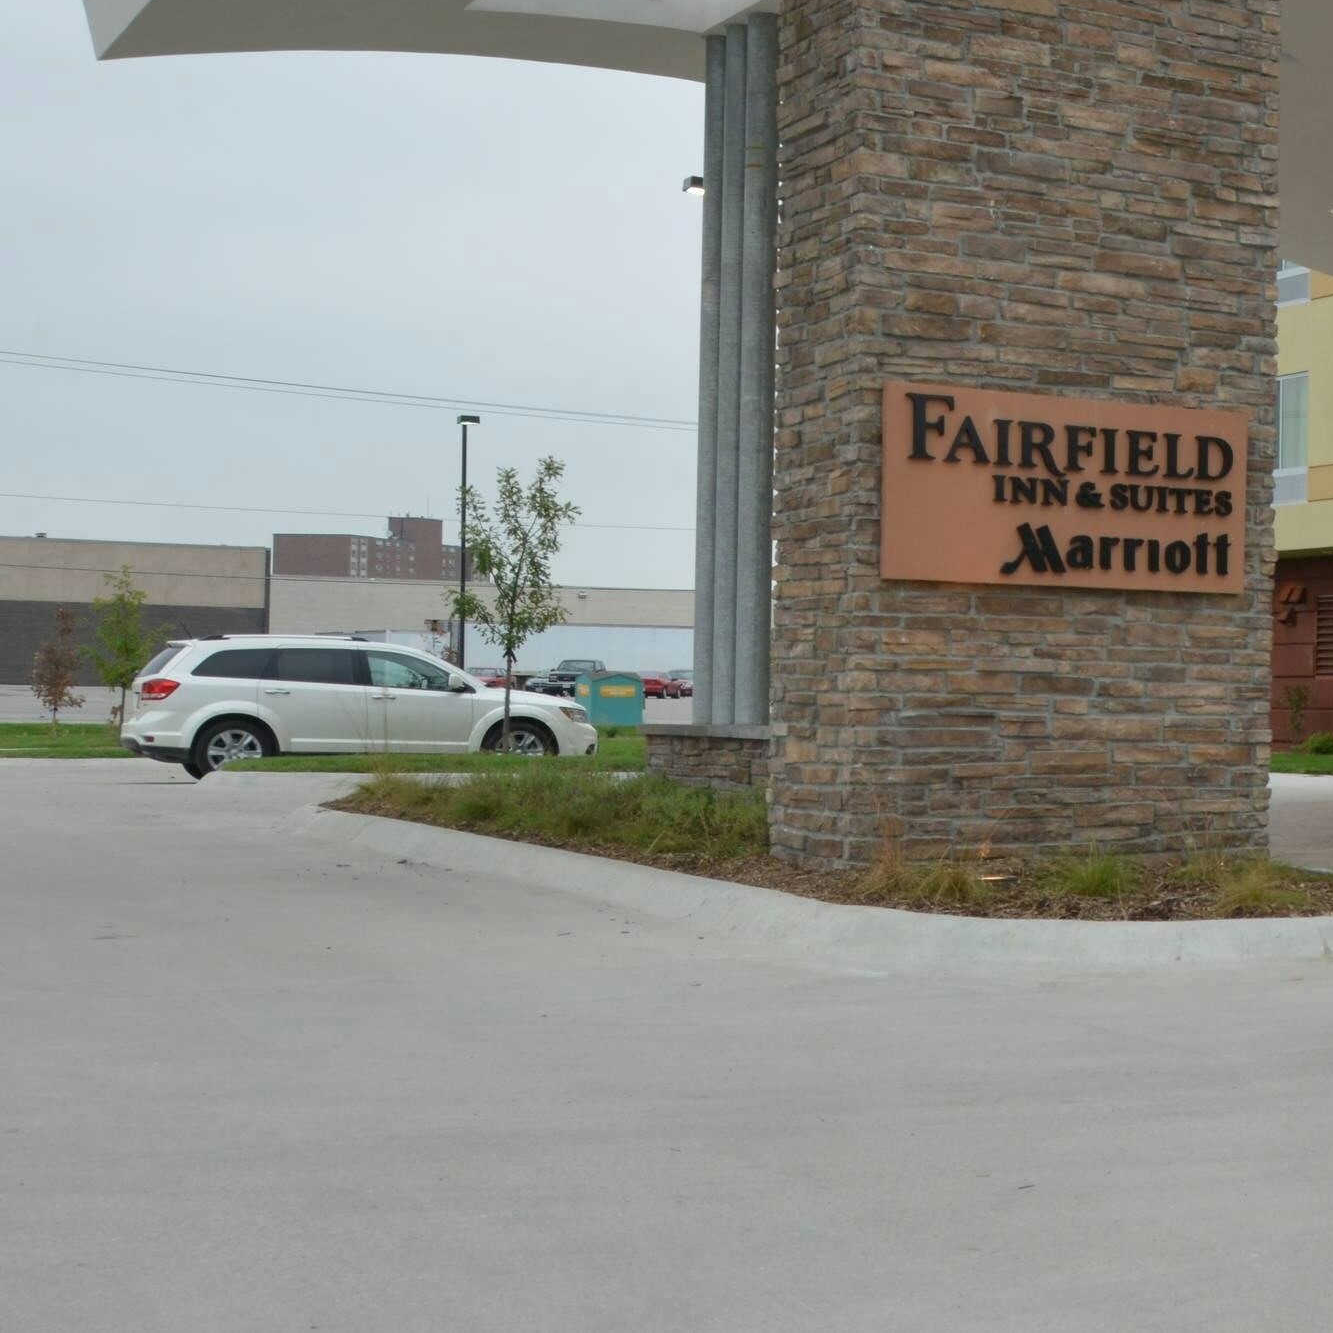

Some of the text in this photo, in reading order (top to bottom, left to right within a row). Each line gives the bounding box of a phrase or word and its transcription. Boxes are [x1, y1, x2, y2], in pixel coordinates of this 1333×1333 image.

[906, 392, 1234, 482] FAIRFIELD
[992, 473, 1070, 507] INN
[1110, 482, 1233, 517] SUITES
[1000, 521, 1232, 576] Marriott
